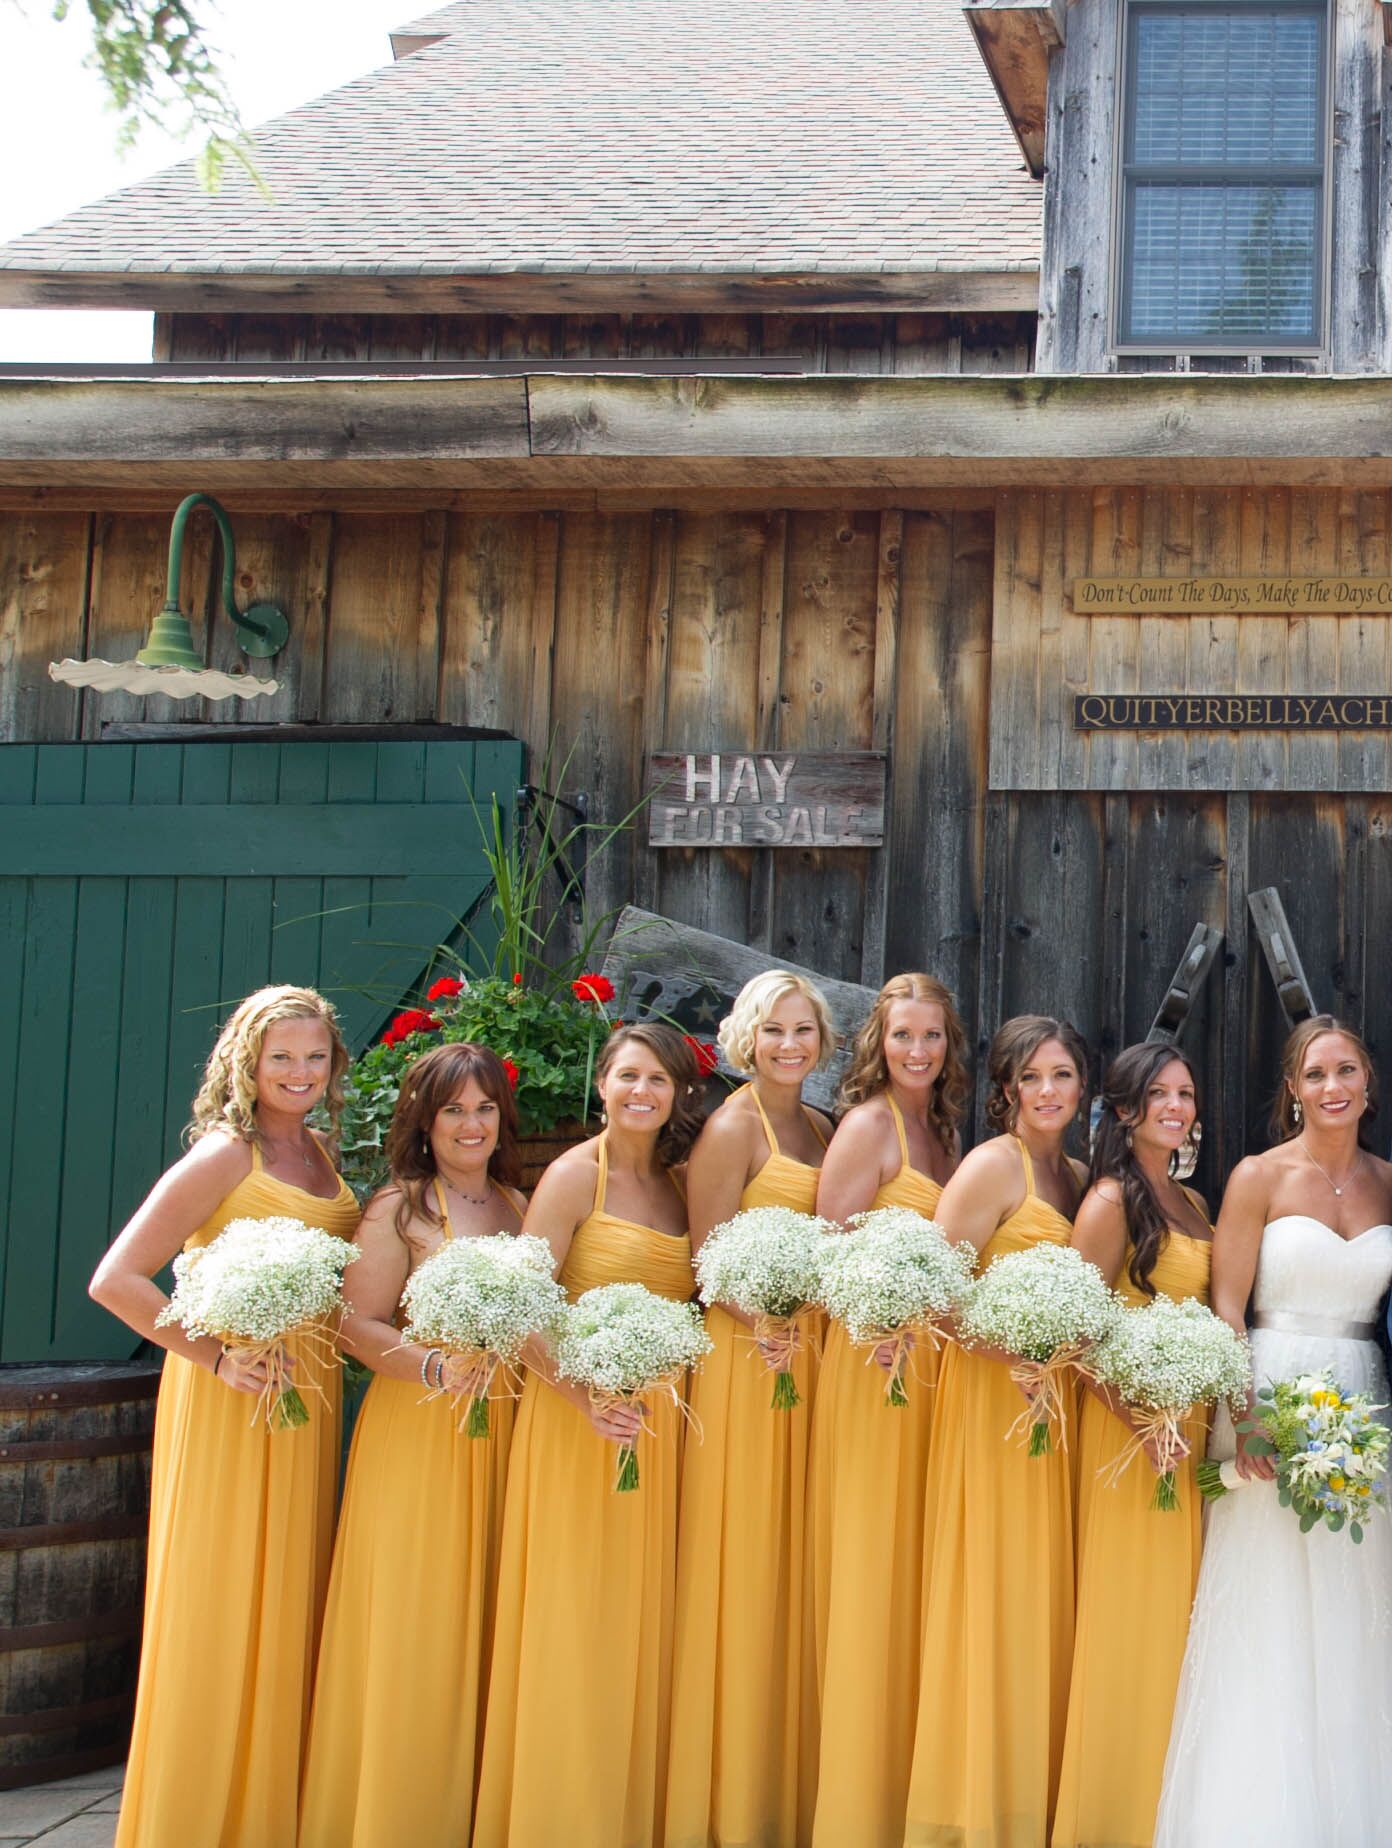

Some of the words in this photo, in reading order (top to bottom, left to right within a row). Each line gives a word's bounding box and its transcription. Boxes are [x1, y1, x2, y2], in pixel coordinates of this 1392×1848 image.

[1082, 583, 1124, 603] Don't
[1129, 582, 1173, 604] Count
[1178, 580, 1205, 603] The
[1209, 582, 1250, 609] Days,
[1256, 580, 1299, 608] Make
[1303, 580, 1330, 603] The
[1334, 582, 1374, 609] Days
[685, 754, 796, 804] HAY
[663, 806, 744, 843] FOR
[753, 805, 865, 843] SALE
